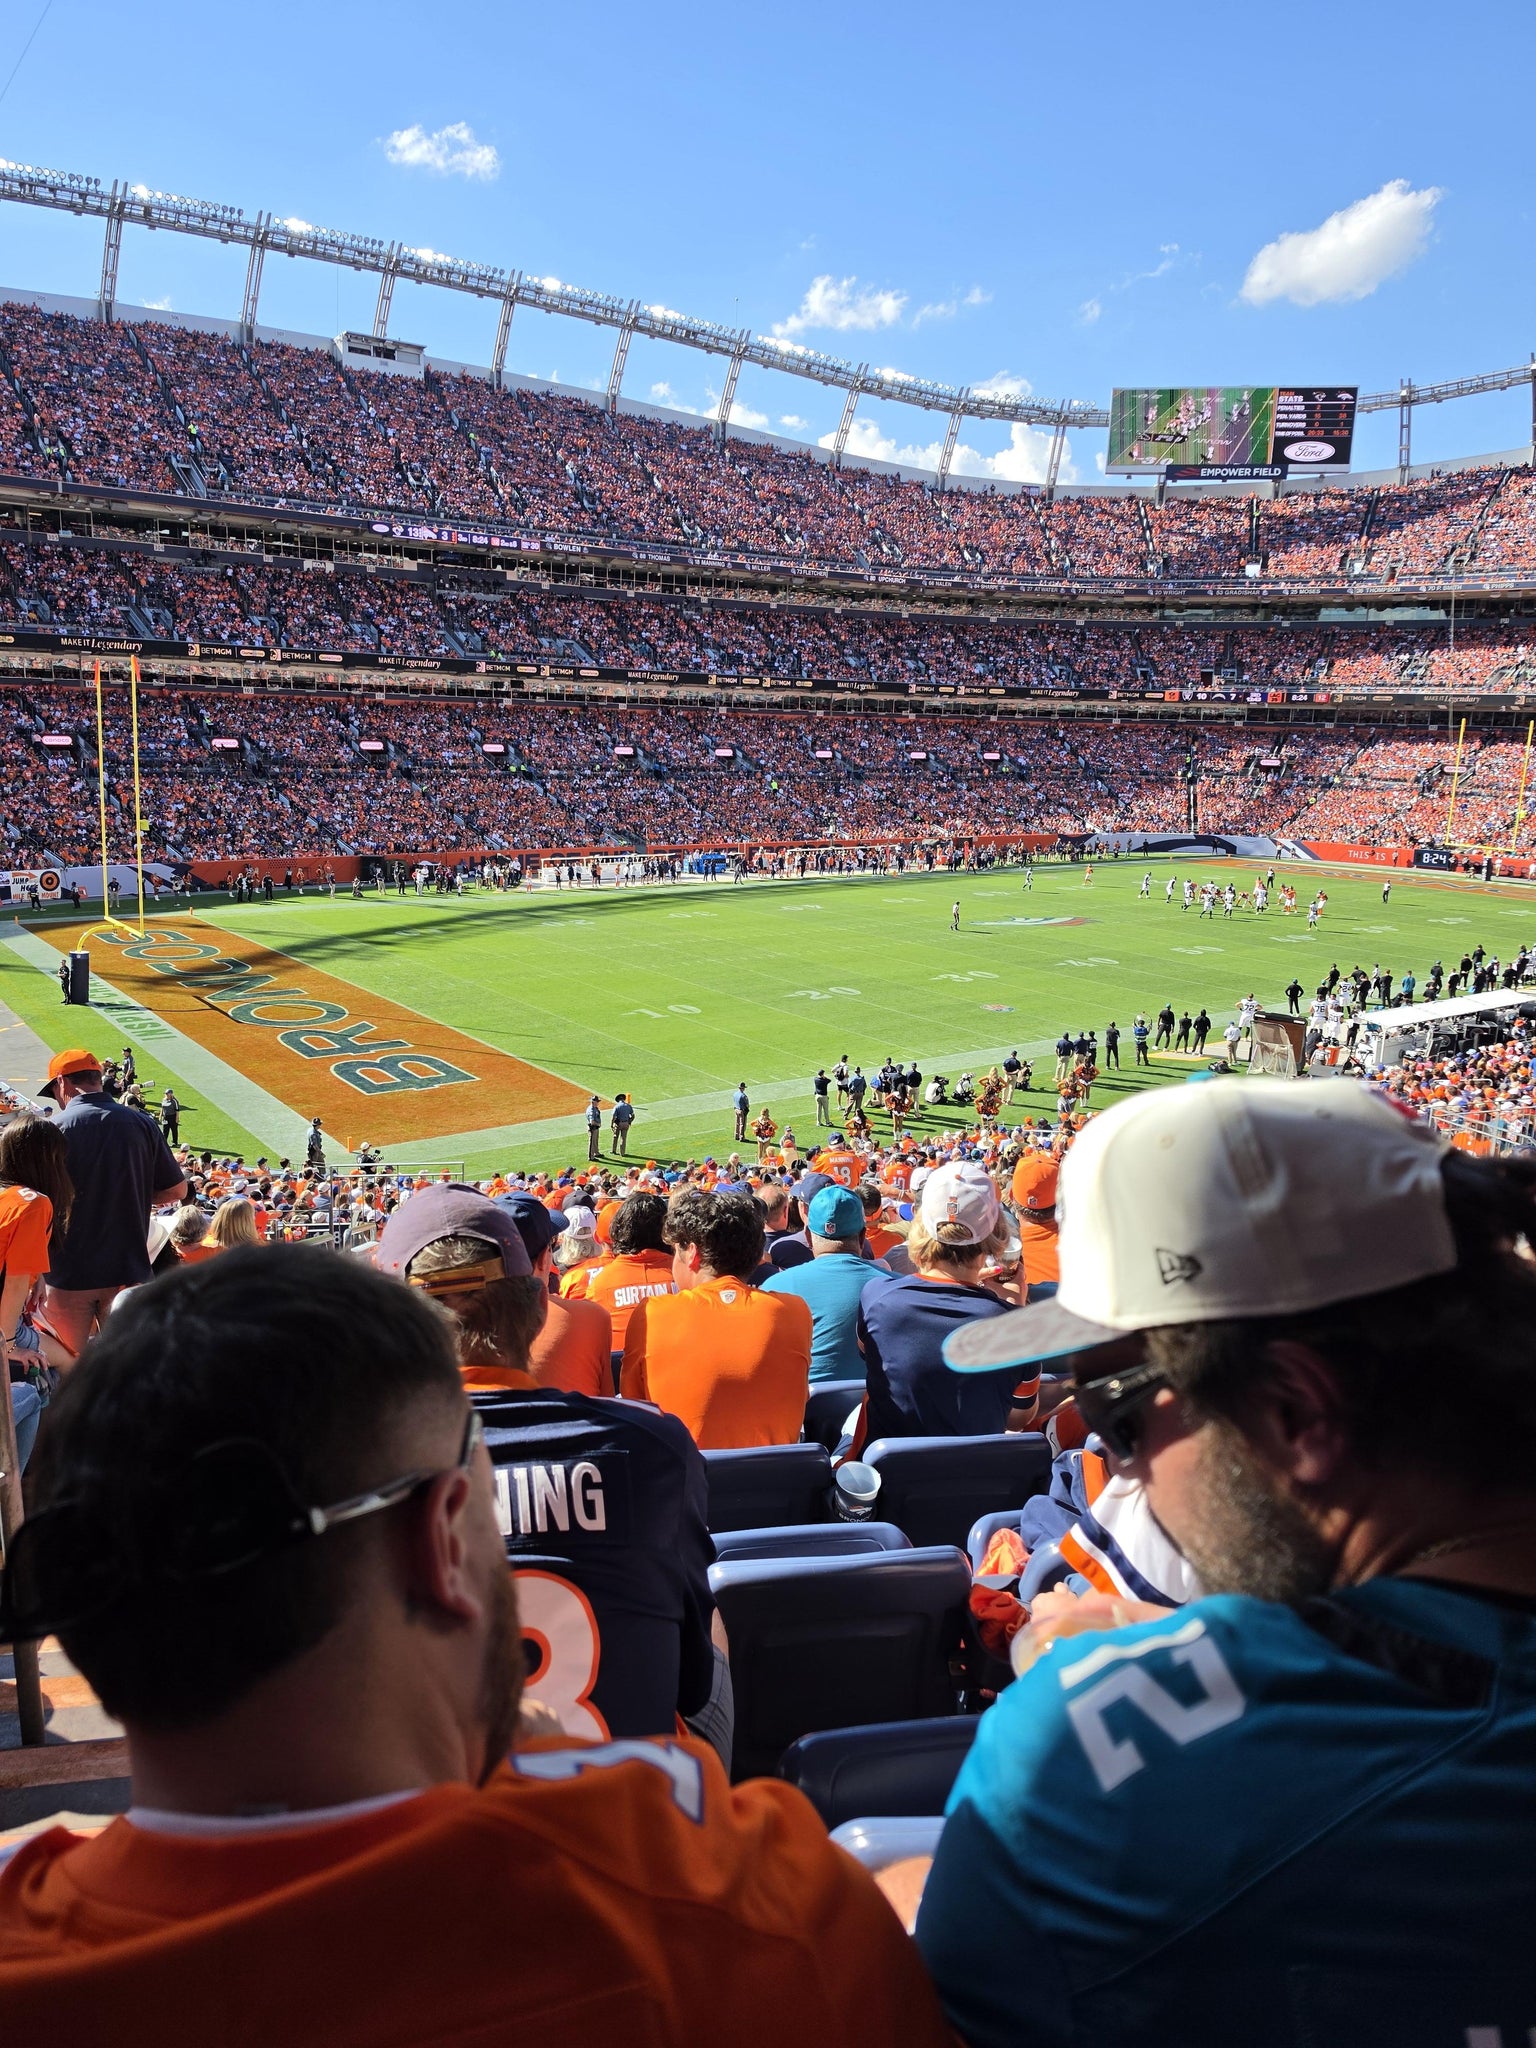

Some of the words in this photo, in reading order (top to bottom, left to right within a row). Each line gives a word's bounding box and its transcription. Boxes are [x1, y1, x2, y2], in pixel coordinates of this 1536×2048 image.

[1294, 444, 1324, 457] Ford
[1200, 467, 1251, 477] EMPOWER
[1253, 466, 1282, 476] FIELD
[442, 531, 449, 541] 3
[472, 535, 488, 545] 8:24
[553, 543, 582, 553] BOWLEN
[648, 554, 672, 562] THOMAS
[701, 559, 726, 568] MANNING
[751, 564, 771, 572] MILLER
[803, 569, 829, 578] FLETCHER
[878, 575, 907, 585] UPCHURCH
[61, 637, 82, 647] MAKE
[83, 639, 90, 648] IT
[91, 639, 143, 652] Legendary
[201, 647, 232, 656] BETMGM
[282, 652, 312, 660] BETMGM
[378, 657, 394, 665] MAKE
[402, 657, 441, 669] Legendary
[486, 663, 511, 672] BETMGM
[550, 668, 574, 676] BETMGM
[647, 673, 679, 683] Legendary
[1048, 690, 1079, 698] Legendary
[1196, 692, 1207, 700] 10
[1317, 694, 1328, 702] 12
[1445, 696, 1481, 704] Legendary
[1347, 850, 1370, 859] THIS
[1375, 851, 1386, 861] IS
[1422, 852, 1446, 864] 8:24
[12, 877, 30, 885] JUMP
[1171, 945, 1225, 955] 50
[1056, 956, 1119, 967] 40
[931, 970, 999, 982] 30
[783, 986, 861, 1001] 20
[93, 928, 481, 1096] BRONCOS
[620, 1004, 702, 1019] 10
[1245, 1003, 1255, 1012] 72
[833, 1166, 851, 1187] 18
[614, 1282, 669, 1308] SURTAIN
